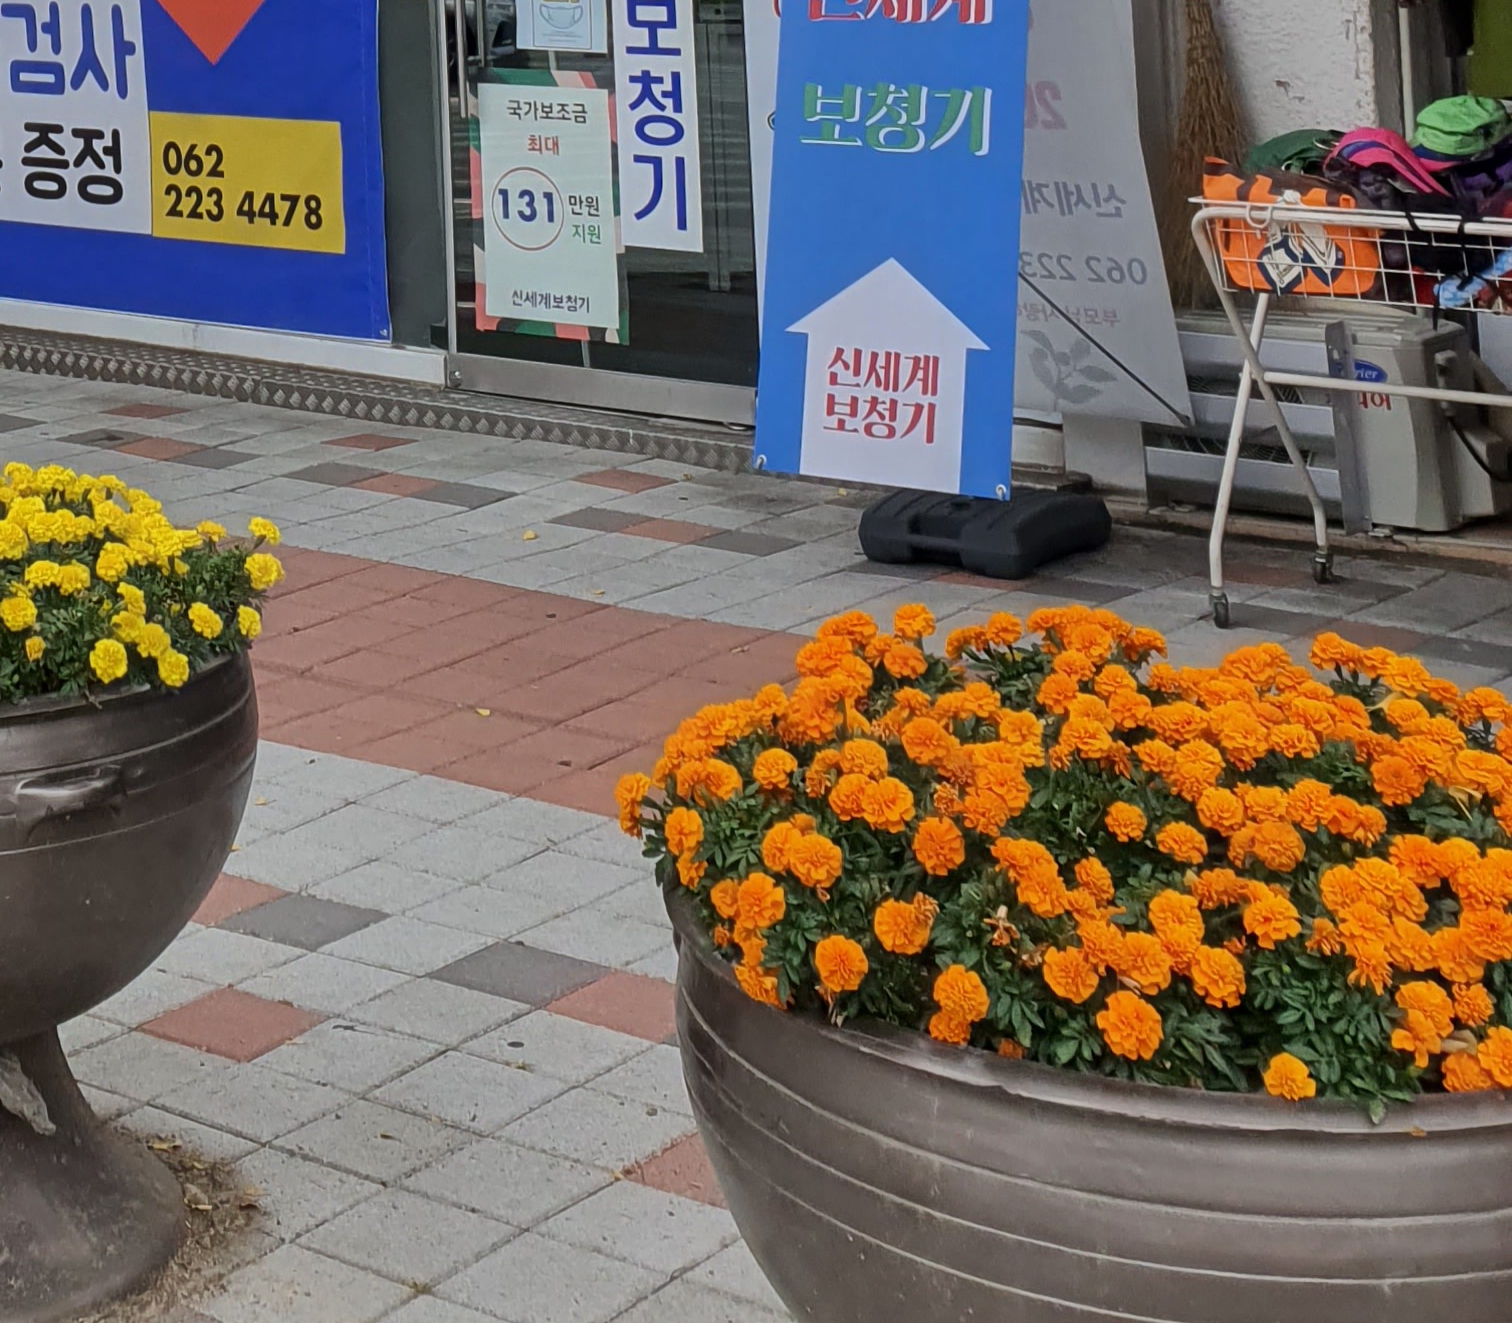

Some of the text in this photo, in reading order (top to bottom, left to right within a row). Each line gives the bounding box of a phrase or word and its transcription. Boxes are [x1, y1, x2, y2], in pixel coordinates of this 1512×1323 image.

[507, 100, 588, 124] 국가보조금
[799, 81, 993, 156] 보청기
[20, 121, 124, 206] 증정
[162, 141, 226, 179] 062
[528, 134, 559, 155] 최대
[164, 183, 324, 230] 223 4478
[498, 188, 601, 223] 131 만원
[572, 224, 601, 244] 지원
[512, 290, 589, 313] 신세계보청기
[826, 346, 940, 397] 신세계
[822, 392, 938, 445] 보청기
